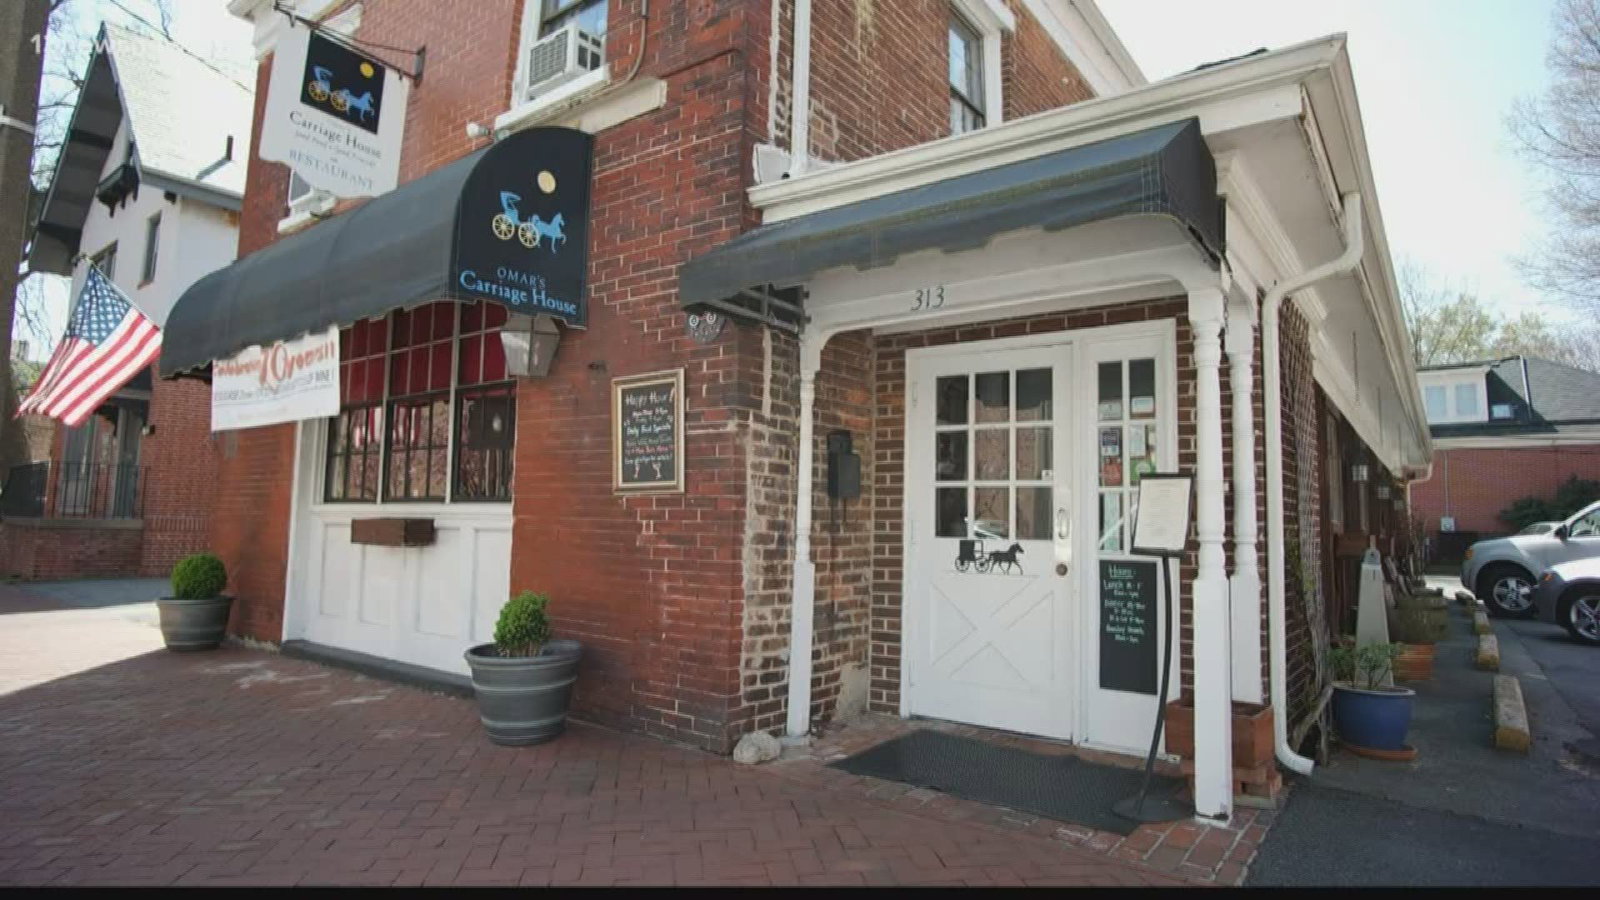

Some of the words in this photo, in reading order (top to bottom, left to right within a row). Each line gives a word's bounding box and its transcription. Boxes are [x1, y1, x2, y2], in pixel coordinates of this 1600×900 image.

[290, 110, 343, 142] Carriage
[345, 133, 382, 160] House
[289, 149, 373, 192] RESTAURANT
[460, 270, 528, 305] Carriage
[532, 287, 577, 316] House
[497, 266, 547, 290] OMAR'S
[911, 286, 945, 311] 313
